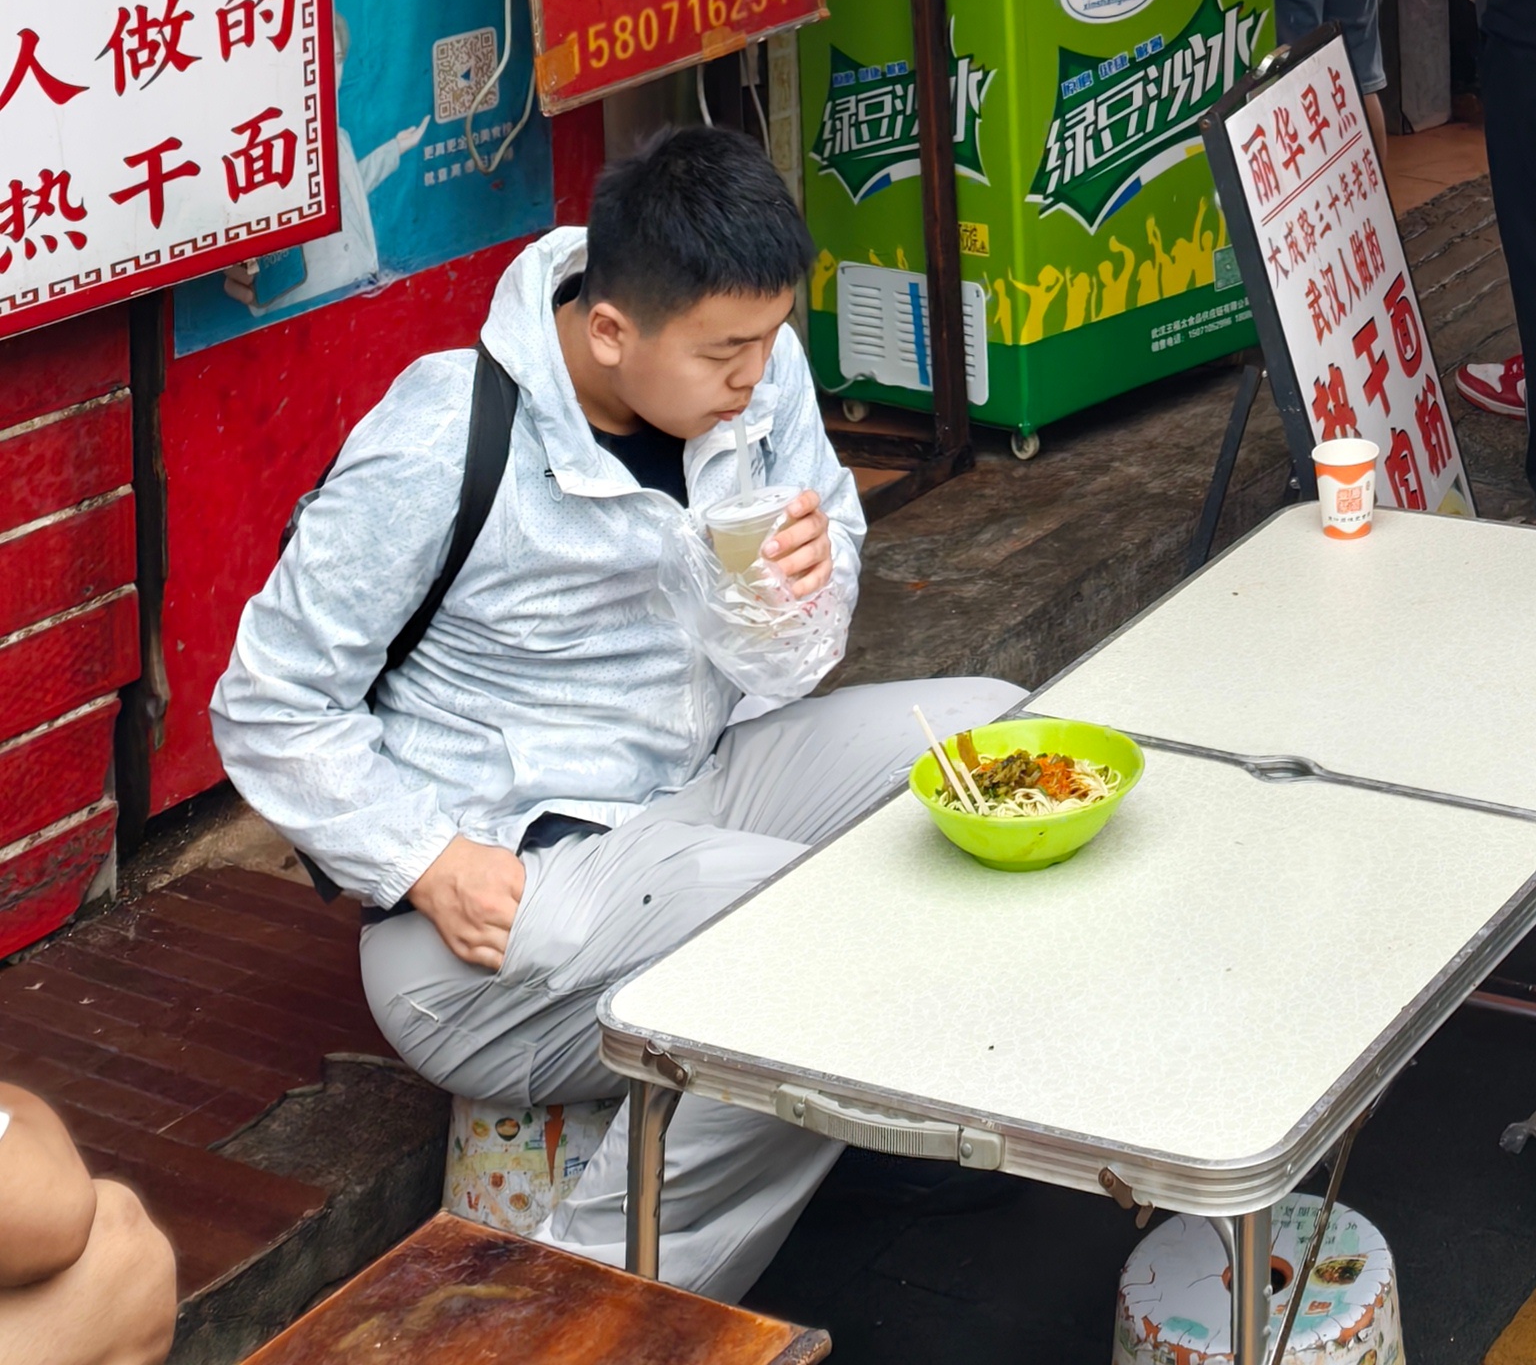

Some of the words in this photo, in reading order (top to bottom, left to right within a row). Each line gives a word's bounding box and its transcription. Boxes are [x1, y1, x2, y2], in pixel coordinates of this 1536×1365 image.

[1045, 7, 1269, 195] 绿豆沙冰
[1241, 66, 1358, 207] 丽华早点
[0, 106, 299, 268] 热干面
[1268, 147, 1379, 289] 大成路三十年老店
[1305, 217, 1384, 346] 武汉人做的
[1312, 271, 1423, 439] 热干面
